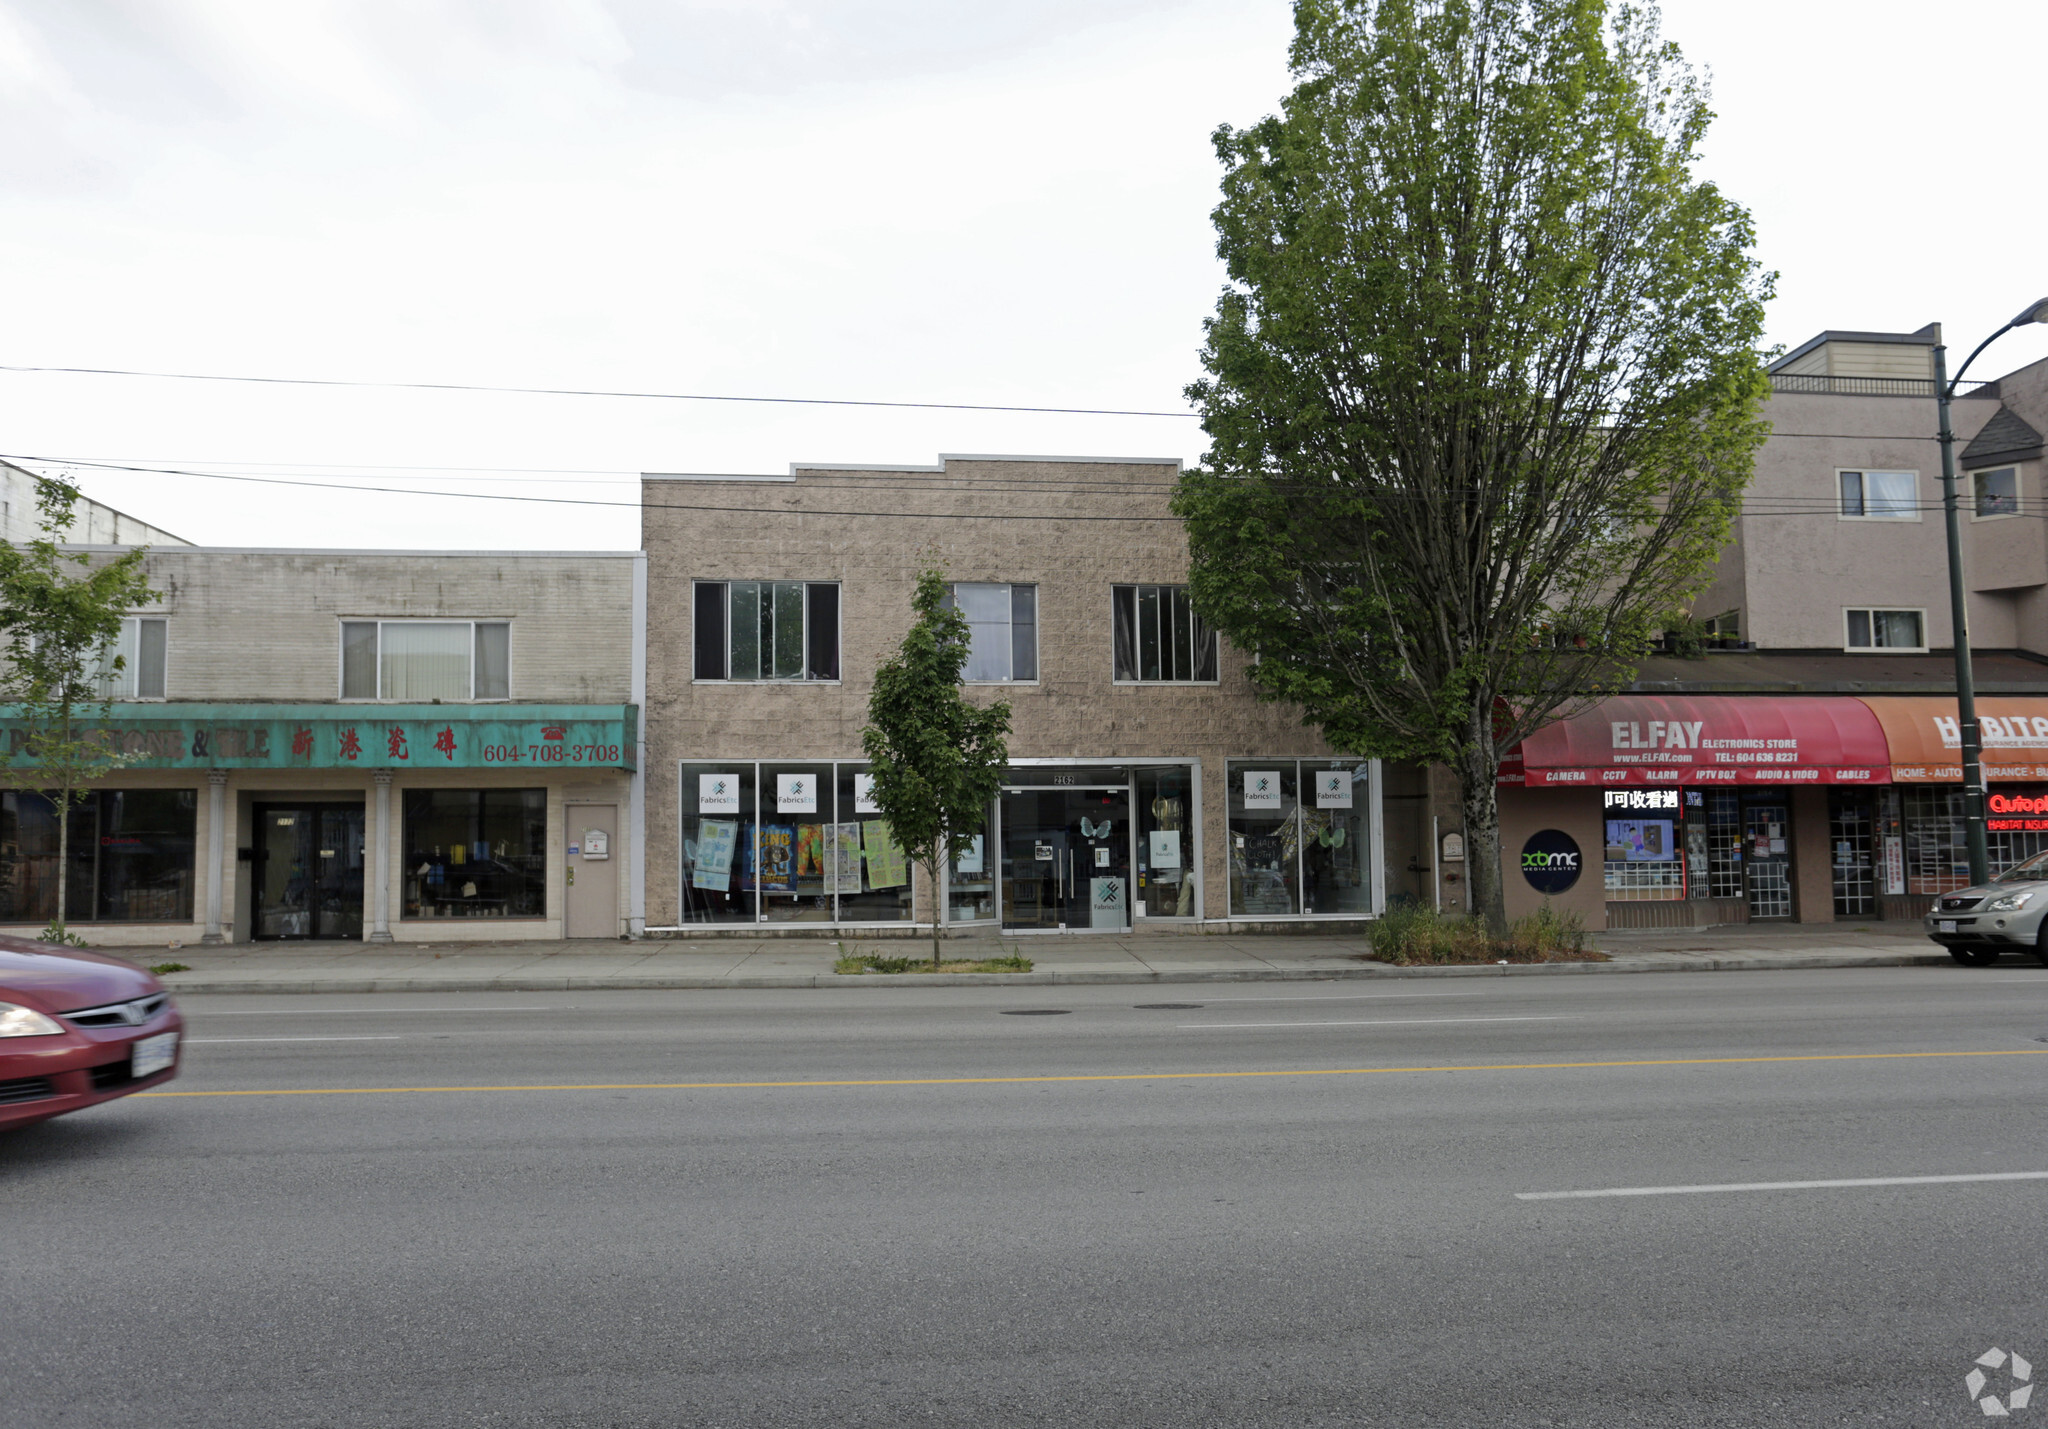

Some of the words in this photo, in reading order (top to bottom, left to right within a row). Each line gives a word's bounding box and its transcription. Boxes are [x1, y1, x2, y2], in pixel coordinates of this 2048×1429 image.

[1933, 716, 2048, 737] HBITA
[1611, 720, 1704, 749] ELFAY
[192, 728, 209, 758] &
[1702, 739, 1765, 749] ELECTRONICS
[1766, 739, 1797, 749] STORE
[484, 744, 620, 763] 604-708-3708
[1613, 752, 1693, 763] www.ELFAY.com
[1715, 752, 1735, 762] TEL:
[1736, 752, 1755, 762] 604
[1756, 752, 1774, 762] 636
[1775, 752, 1798, 762] 8231
[1546, 771, 1586, 781] CAMERA
[1602, 770, 1627, 780] CCTV
[1646, 770, 1679, 780] ALARM
[1696, 770, 1717, 780] IPTV
[1718, 770, 1737, 780] BOX
[1755, 770, 1782, 780] AUDIO
[1783, 770, 1791, 780] &
[1792, 770, 1819, 780] VIDEO
[1836, 770, 1871, 780] CABLES
[1896, 767, 1926, 778] HOME
[1934, 767, 1962, 777] AUTO
[1986, 767, 2025, 777] URANCE
[1055, 776, 1074, 784] 2162
[1987, 819, 2023, 830] HABITAT
[1521, 850, 1579, 867] xbmc
[751, 875, 789, 884] IRCUS
